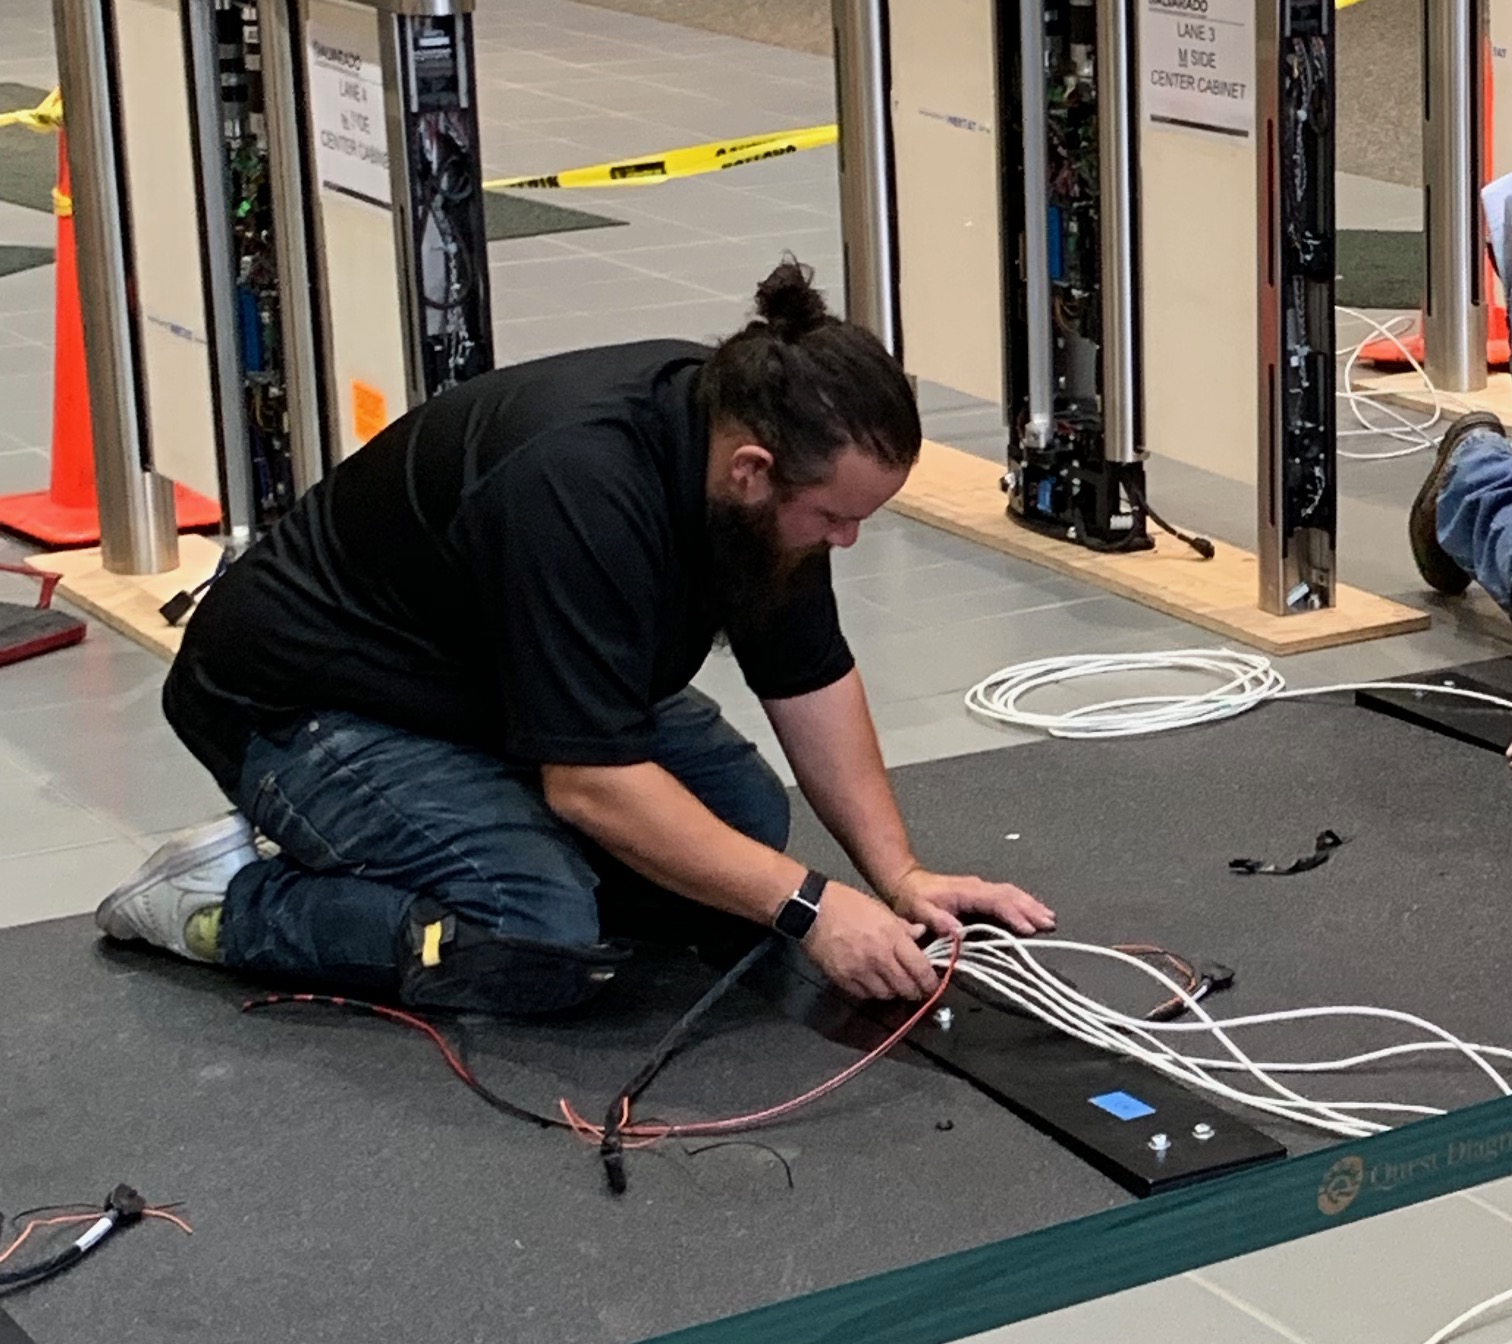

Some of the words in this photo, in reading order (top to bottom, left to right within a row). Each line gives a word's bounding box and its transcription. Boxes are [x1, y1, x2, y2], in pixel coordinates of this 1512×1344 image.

[1177, 22, 1206, 41] LANE
[1208, 26, 1216, 42] 3
[1178, 47, 1188, 67] M
[1190, 49, 1217, 69] SIDE
[1151, 69, 1195, 91] CENTER
[1197, 77, 1247, 99] CABINET
[1371, 1150, 1438, 1191] Quest
